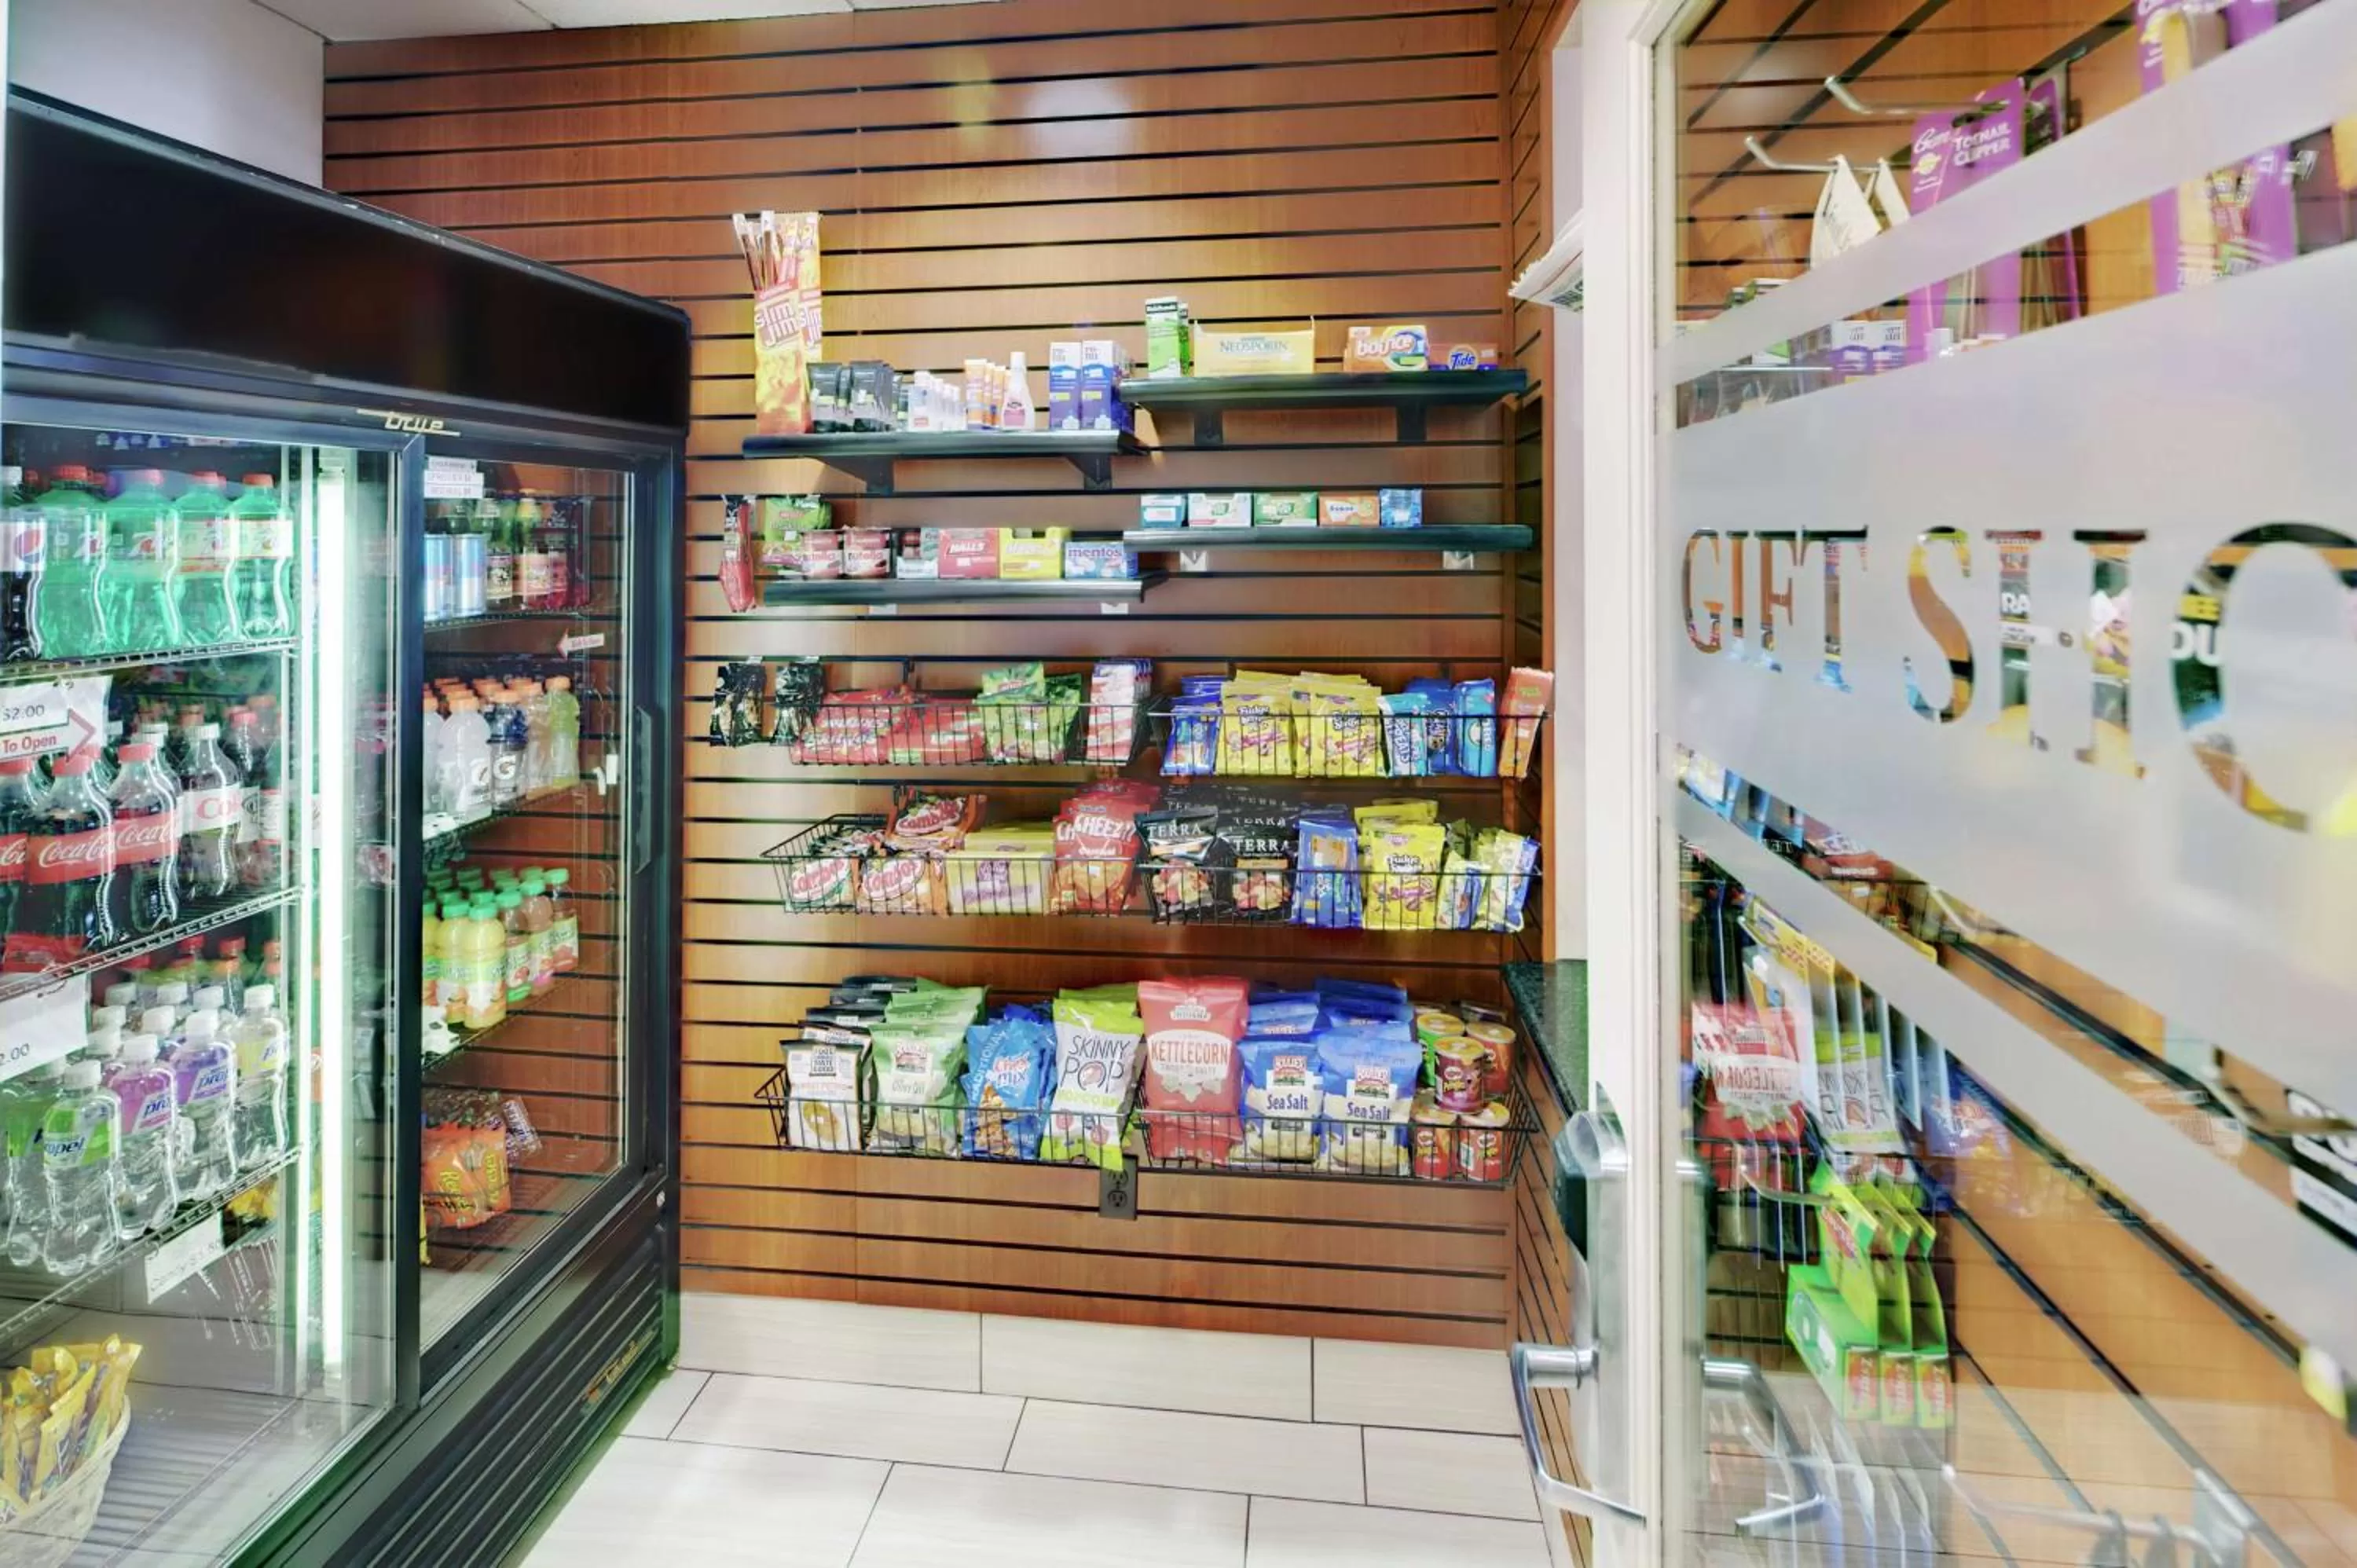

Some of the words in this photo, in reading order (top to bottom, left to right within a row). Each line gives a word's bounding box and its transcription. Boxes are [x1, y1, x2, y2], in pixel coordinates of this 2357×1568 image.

[1450, 351, 1477, 370] Tide
[1067, 545, 1124, 559] mentos
[1681, 525, 1869, 693] GIFT
[2, 739, 18, 753] To
[22, 735, 57, 752] Open
[1146, 822, 1202, 839] TERRA
[1233, 838, 1291, 853] TERRA
[1069, 1034, 1131, 1060] SKINNY
[1150, 1040, 1228, 1065] KETTLECORN
[1060, 1055, 1124, 1094] POP
[1266, 1093, 1285, 1111] Sea
[1286, 1093, 1309, 1111] Salt
[1347, 1101, 1368, 1118] Sea
[1369, 1104, 1391, 1121] Salt
